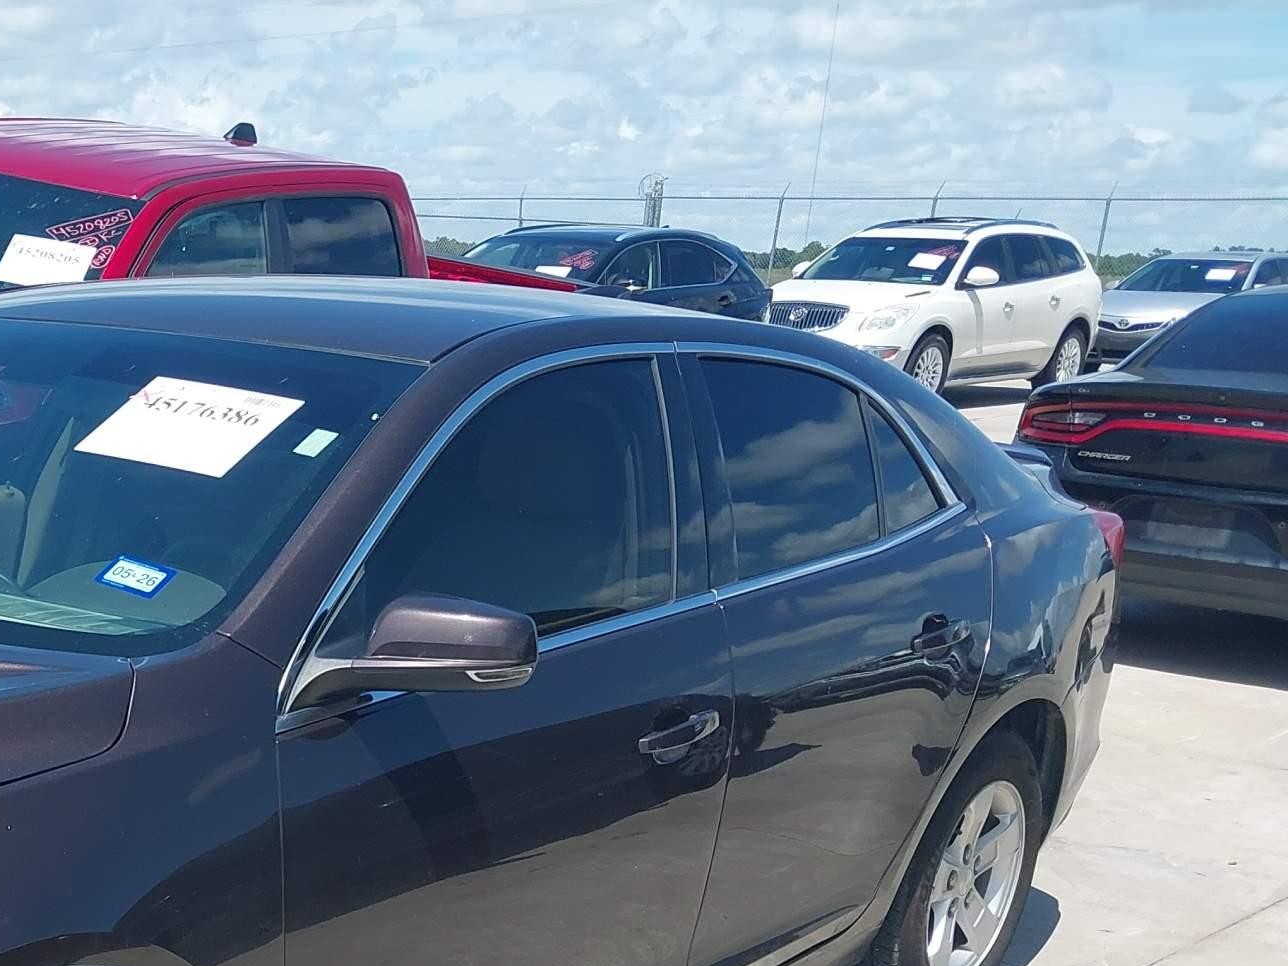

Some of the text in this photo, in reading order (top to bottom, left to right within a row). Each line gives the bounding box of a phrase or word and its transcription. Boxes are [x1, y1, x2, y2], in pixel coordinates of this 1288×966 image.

[52, 212, 129, 238] 45208205
[144, 396, 274, 427] 45176386
[1077, 450, 1132, 462] CHARGER
